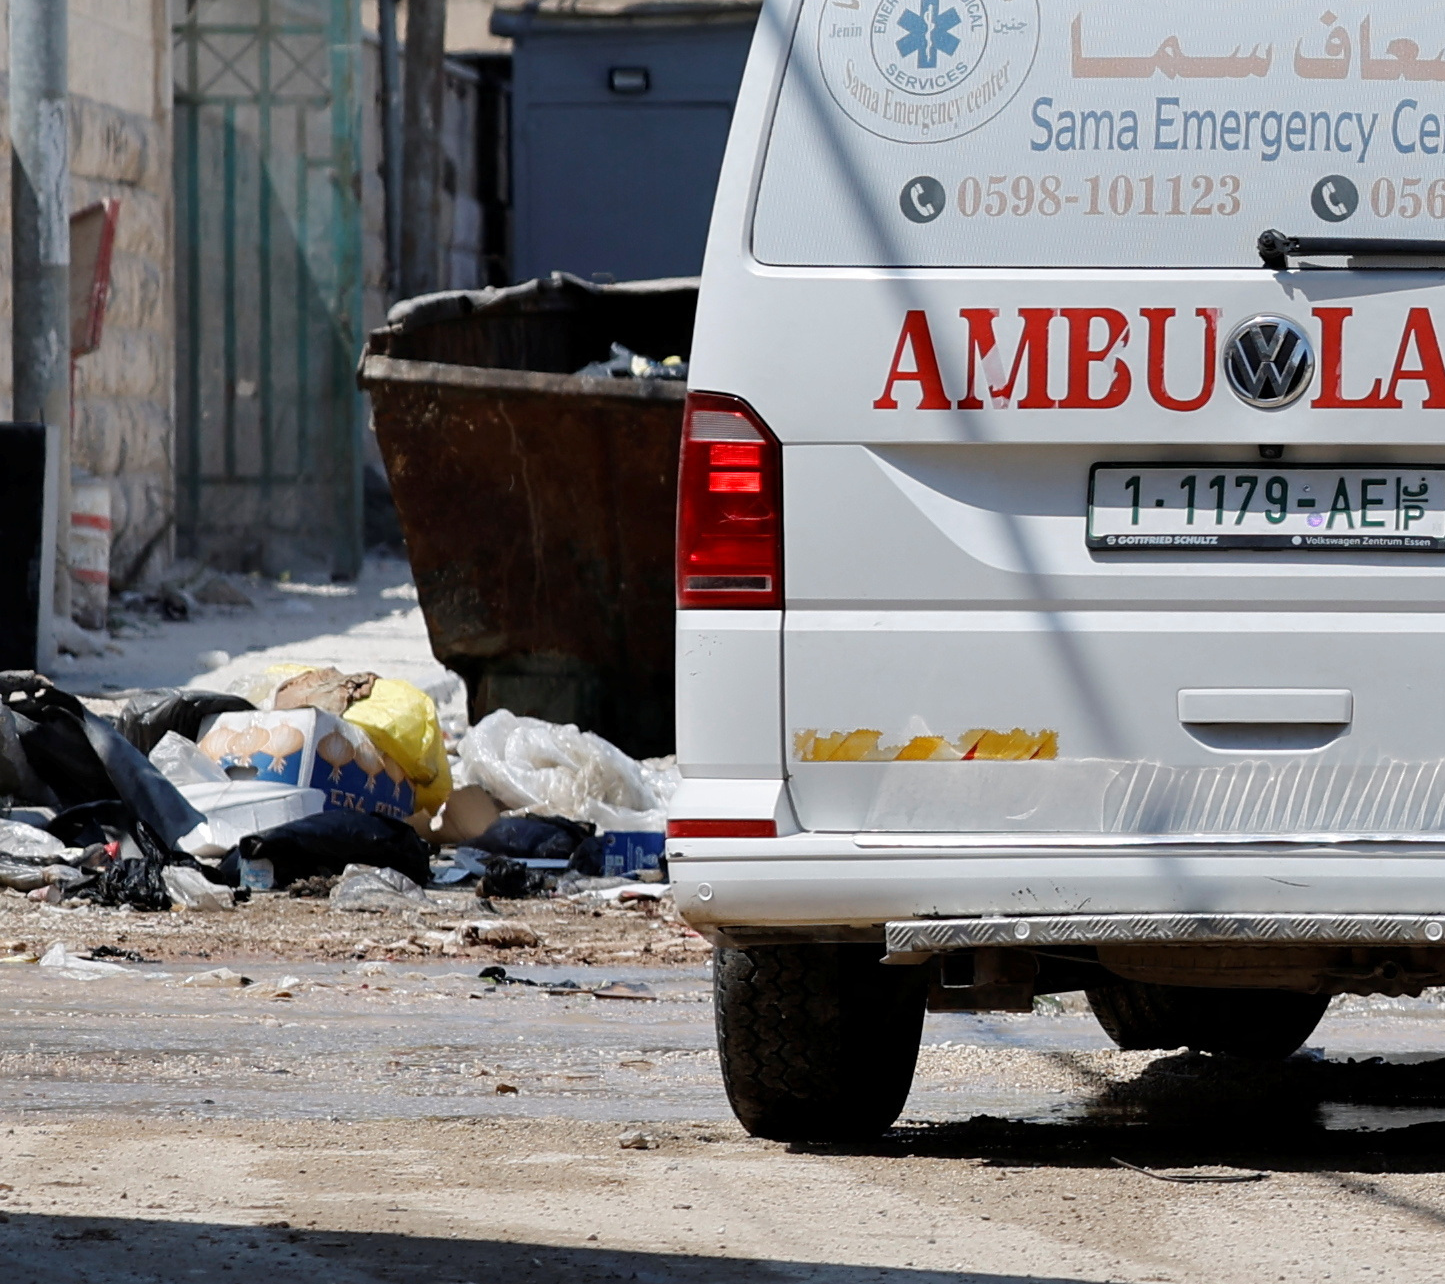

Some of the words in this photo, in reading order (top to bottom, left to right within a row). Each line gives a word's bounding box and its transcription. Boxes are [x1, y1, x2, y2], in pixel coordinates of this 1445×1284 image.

[829, 23, 862, 39] Jenin
[993, 20, 1028, 35] جنين
[1070, 10, 1273, 79] سما
[885, 61, 969, 91] SERVICES
[842, 58, 880, 115] Sama
[882, 87, 964, 136] Emergency
[966, 59, 1011, 113] center
[1030, 96, 1139, 153] Sama
[1153, 96, 1379, 163] Emergency
[957, 174, 1242, 218] 0598-101123
[1117, 535, 1172, 546] GOTTFRIED
[1173, 535, 1219, 546] SCHULTZ
[1305, 536, 1361, 548] Volkswagen
[1362, 537, 1403, 547] Zentrum
[1404, 537, 1431, 547] Essen
